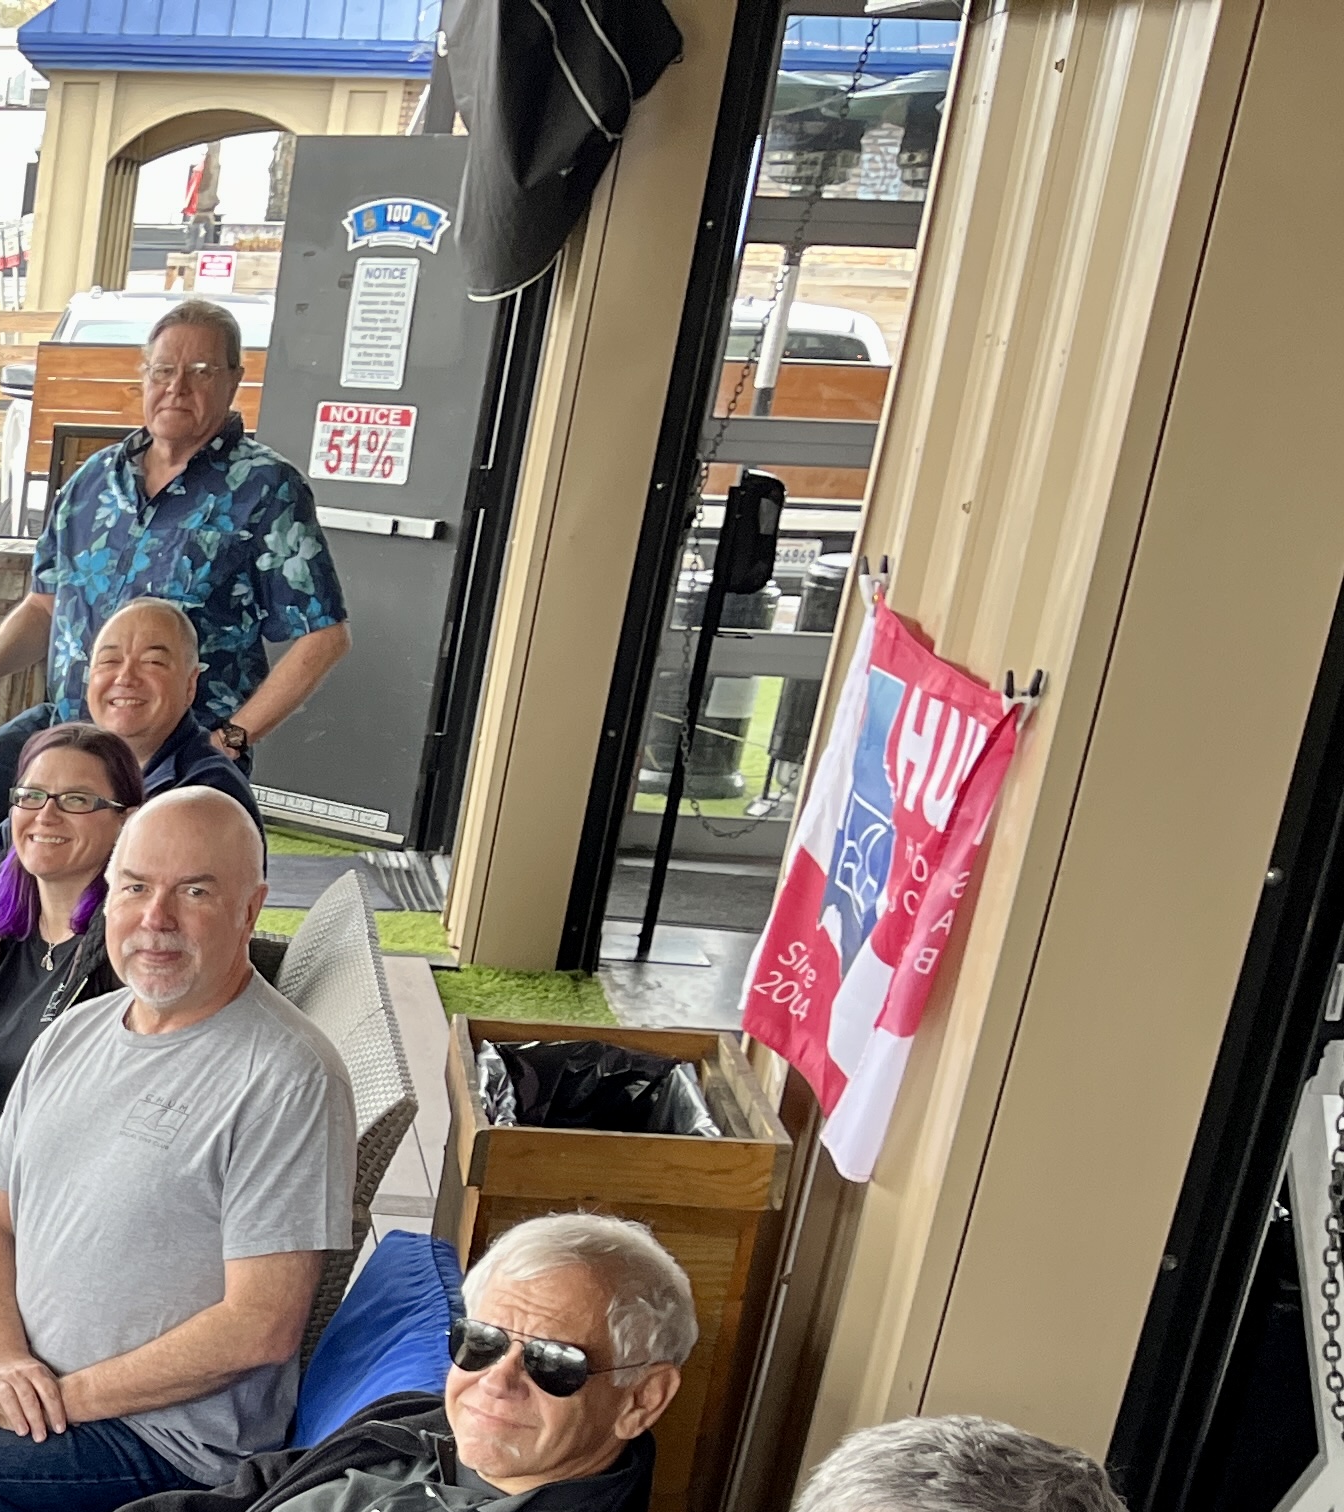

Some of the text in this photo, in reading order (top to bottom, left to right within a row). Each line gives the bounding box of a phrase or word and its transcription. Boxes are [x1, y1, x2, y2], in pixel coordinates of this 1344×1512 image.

[386, 204, 412, 223] 100
[364, 267, 408, 280] NOTICE
[329, 406, 402, 425] NOTICE
[324, 429, 394, 479] 51%
[896, 686, 988, 833] HU
[145, 1093, 189, 1114] CHUM
